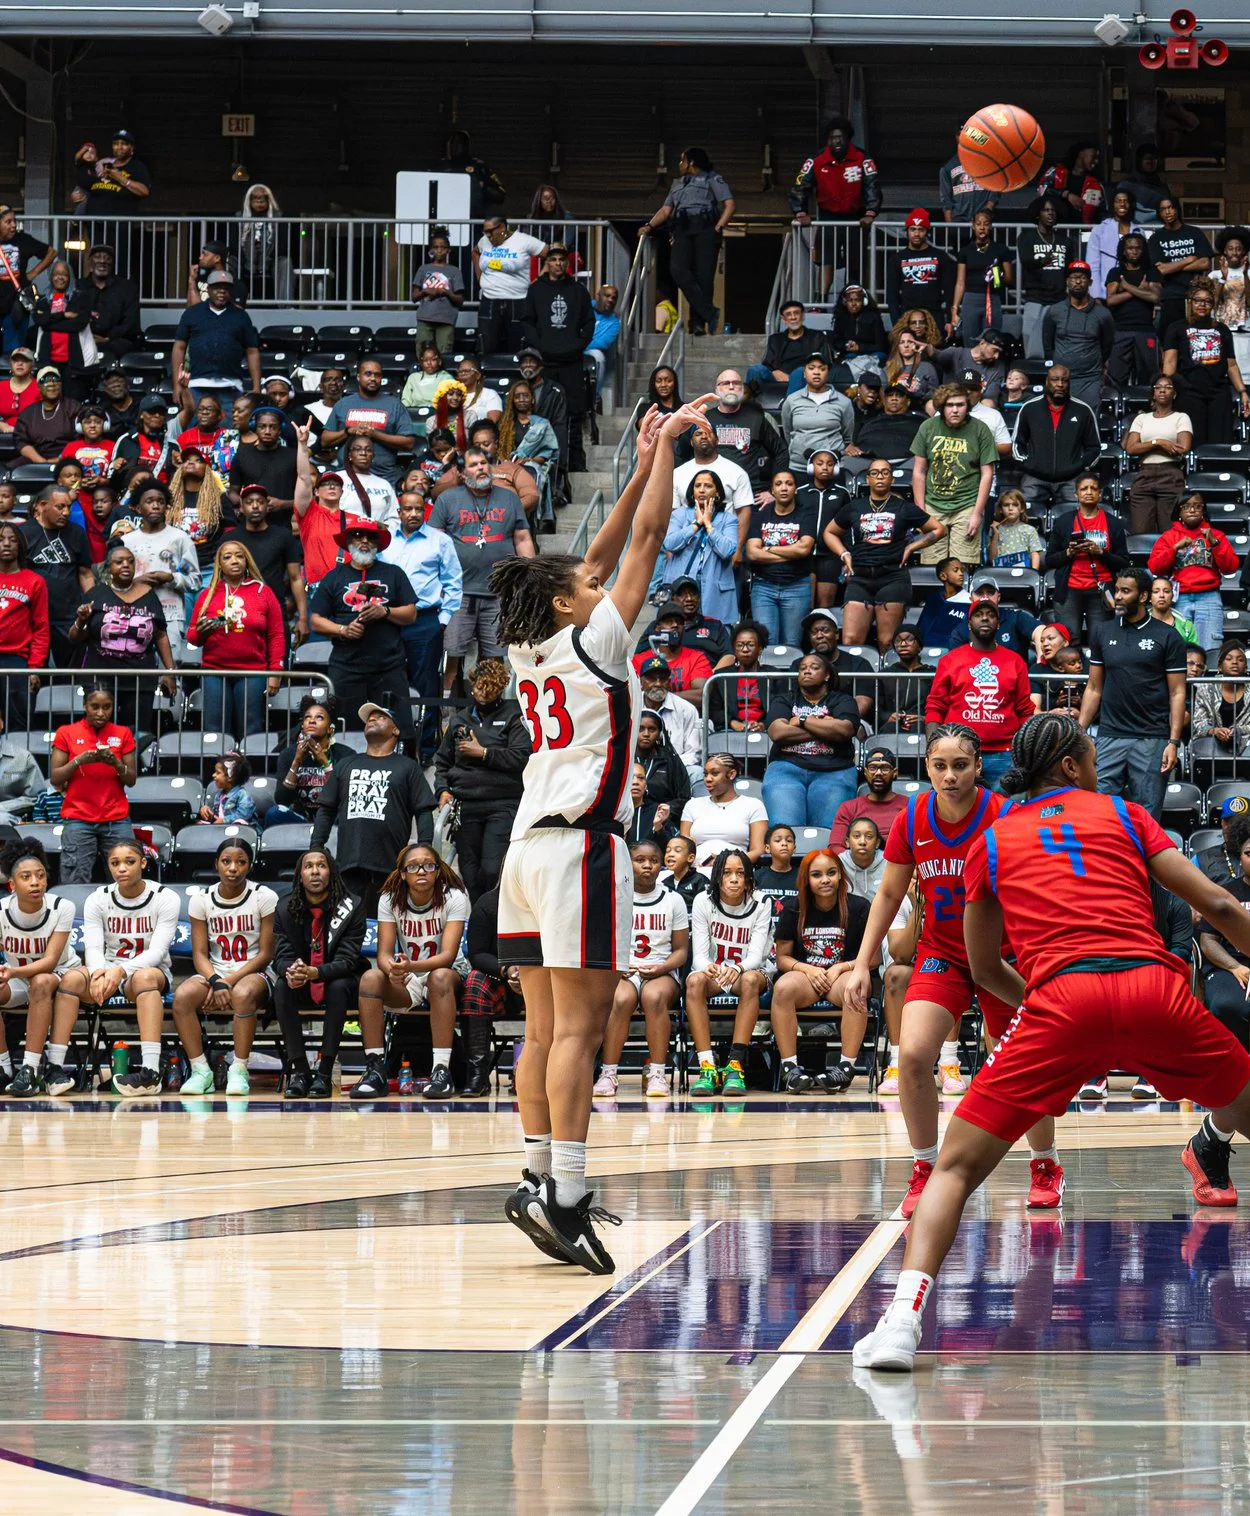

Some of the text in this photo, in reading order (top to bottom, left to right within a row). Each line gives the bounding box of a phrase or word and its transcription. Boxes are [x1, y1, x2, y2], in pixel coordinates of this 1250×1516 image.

[228, 117, 251, 132] EXIT
[931, 436, 968, 453] ZELDA
[519, 676, 575, 752] 33
[962, 710, 981, 720] Old
[982, 710, 1004, 722] Navy
[350, 768, 392, 781] PRAY
[349, 784, 389, 798] PRAY
[348, 800, 387, 814] PRAY
[1038, 823, 1086, 877] 4
[107, 916, 154, 934] CEDAR HILL
[211, 914, 255, 934] CEDAR HILL
[400, 918, 443, 937] CEDAR HILL
[649, 914, 667, 931] HILL
[710, 921, 733, 942] CEDAR
[5, 936, 32, 954] CEDAR
[116, 938, 145, 959] 21
[634, 935, 652, 958] 3
[715, 944, 743, 966] 15
